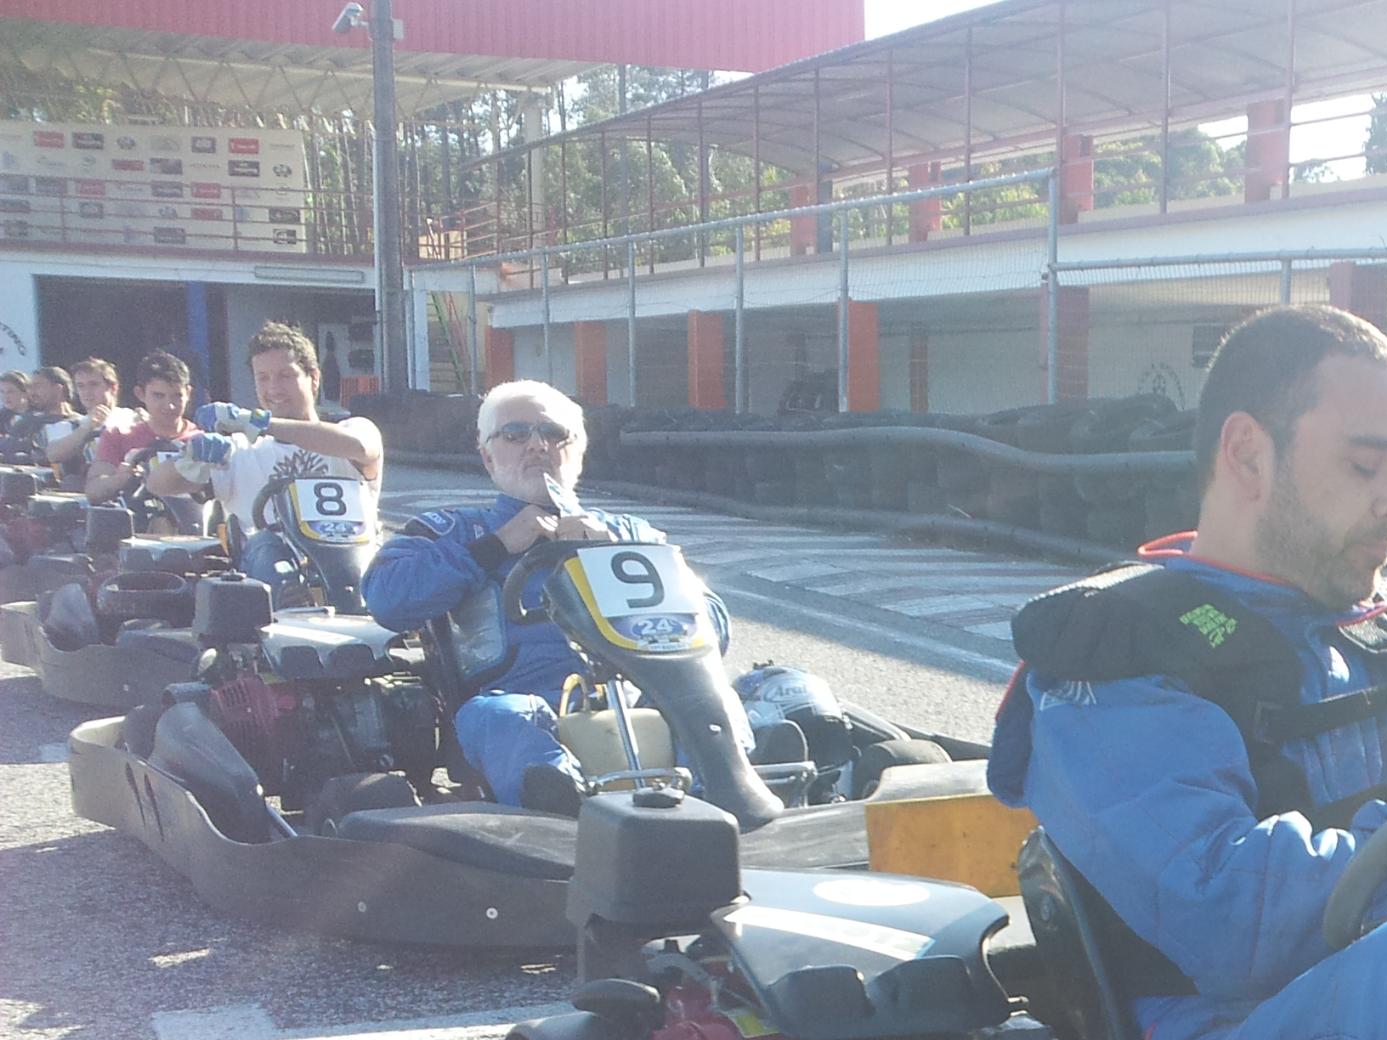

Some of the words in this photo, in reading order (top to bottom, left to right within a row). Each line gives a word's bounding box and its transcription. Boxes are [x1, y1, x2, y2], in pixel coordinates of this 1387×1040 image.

[313, 482, 347, 516] 8
[610, 551, 665, 609] 9
[638, 618, 674, 635] 24
